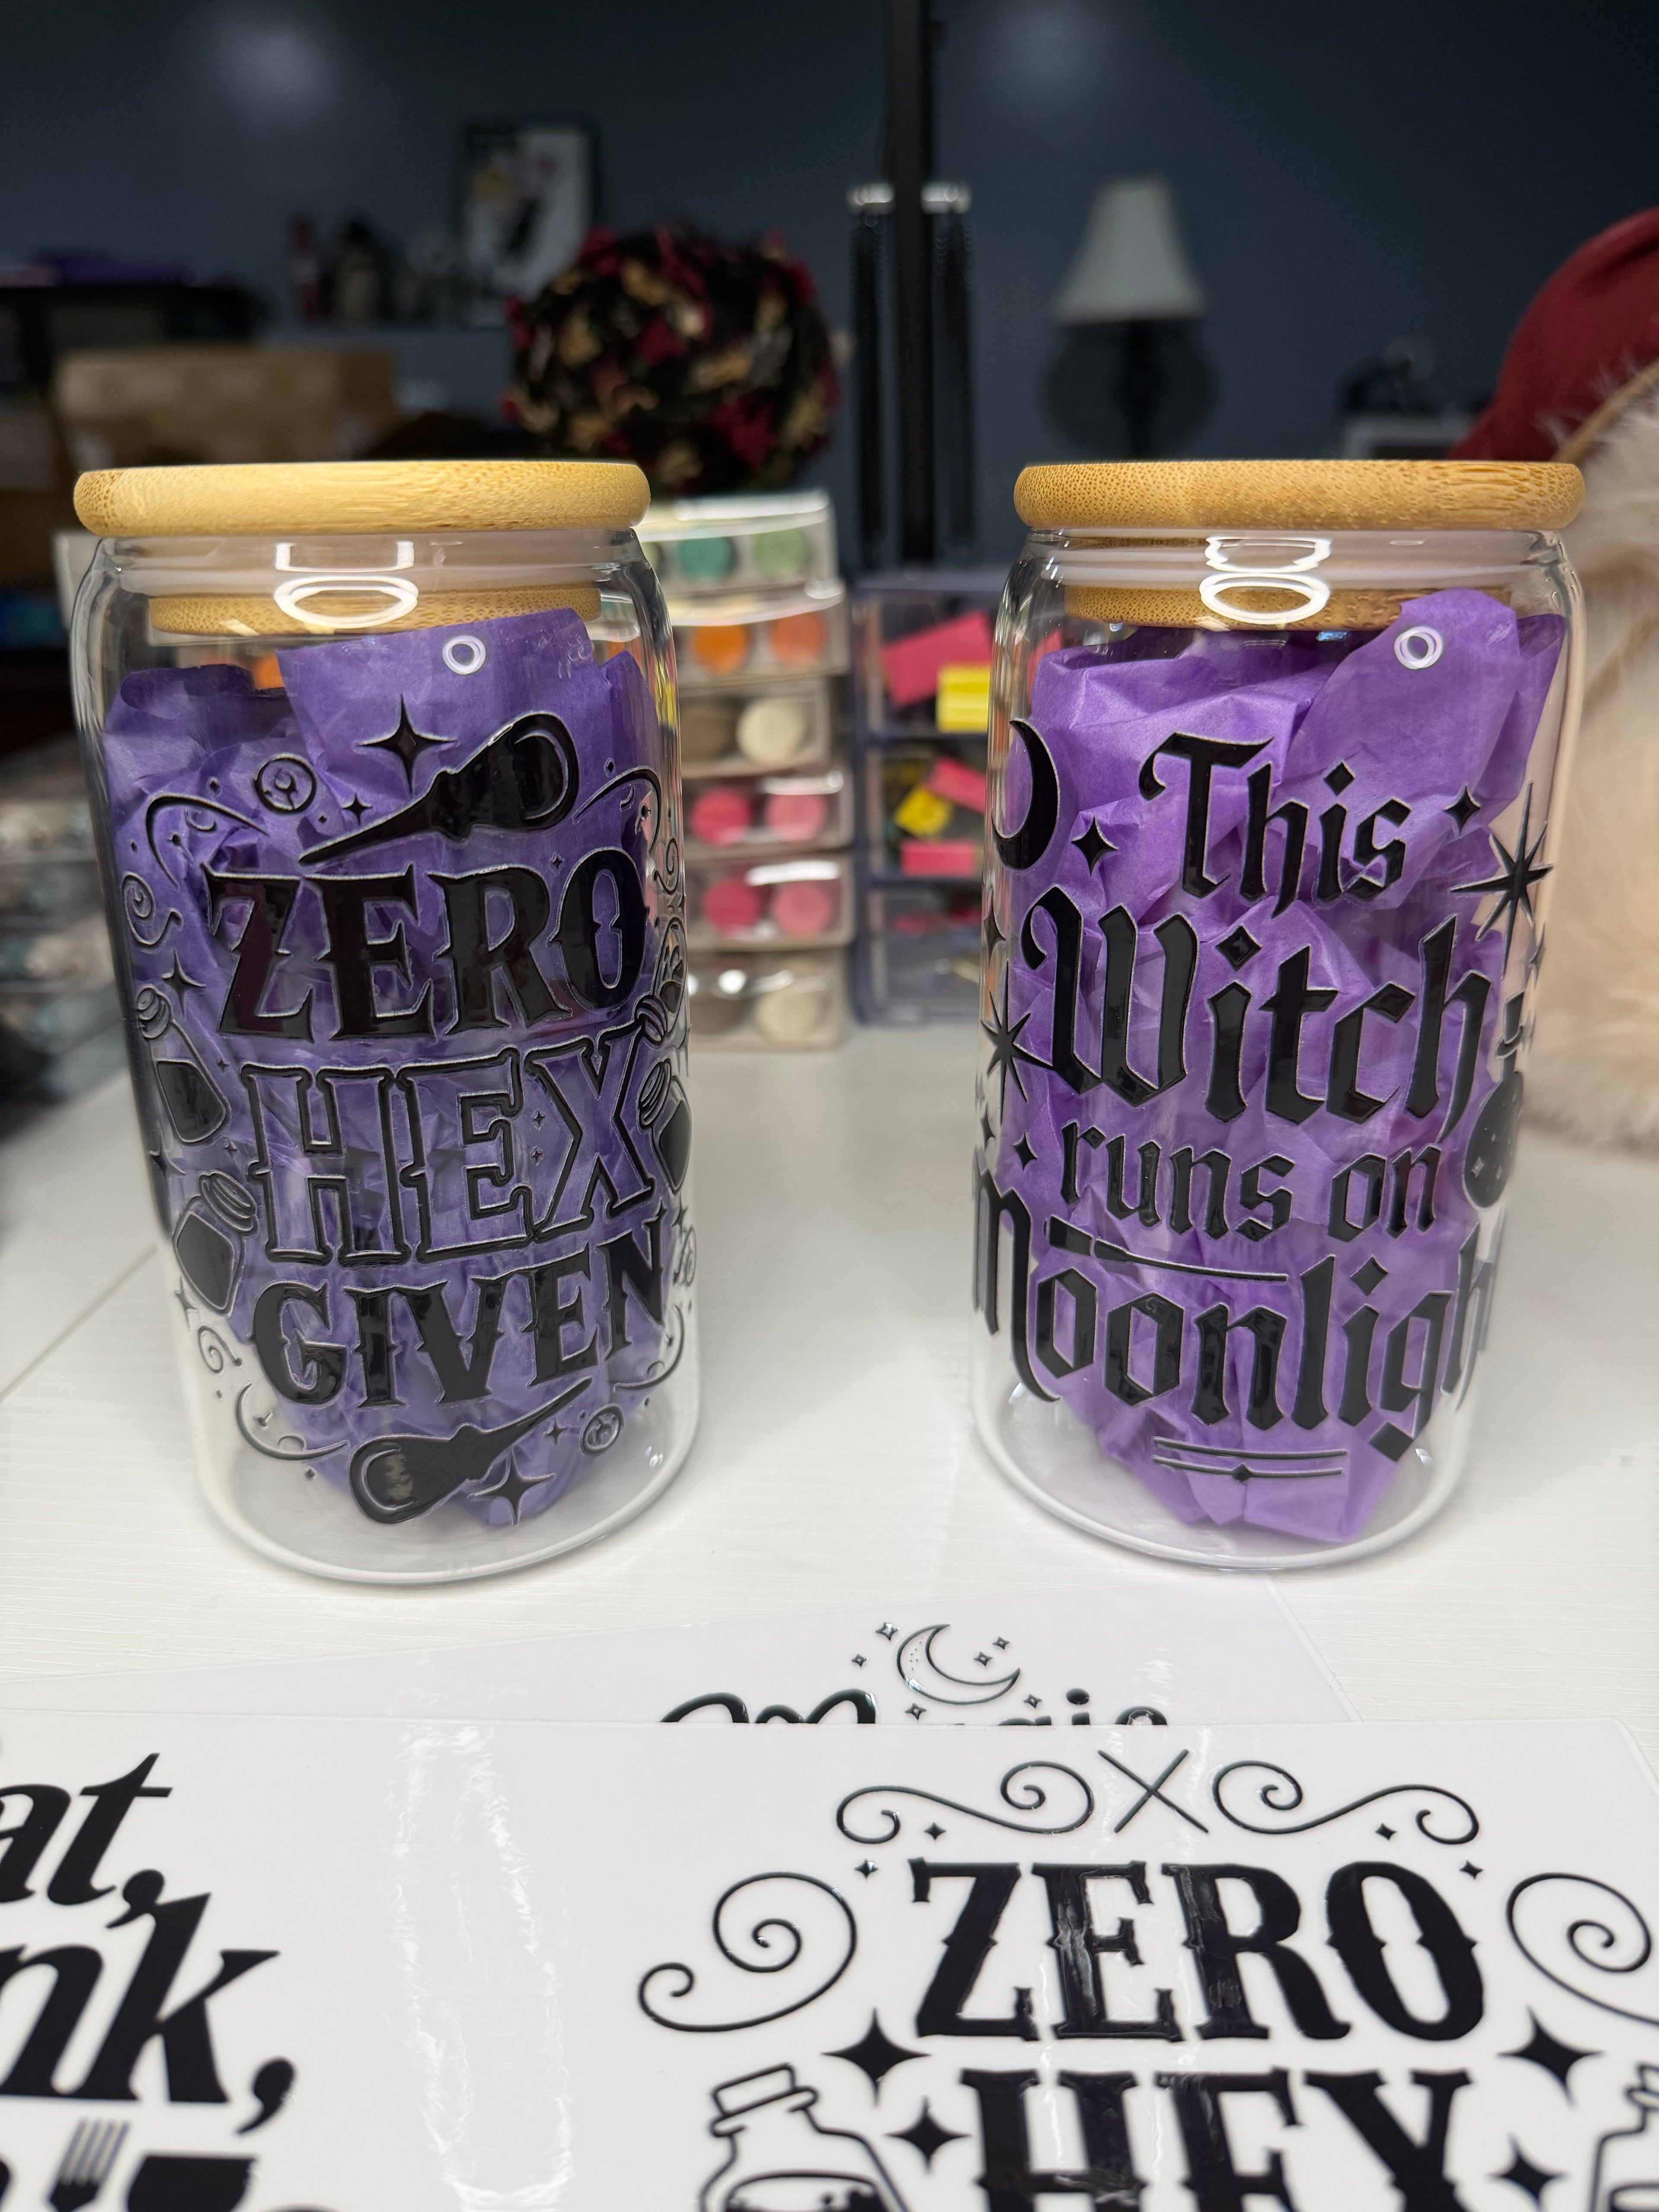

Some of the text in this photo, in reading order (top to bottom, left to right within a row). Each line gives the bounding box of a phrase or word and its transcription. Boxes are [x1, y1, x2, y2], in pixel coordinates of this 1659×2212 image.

[1138, 731, 1412, 918] This
[202, 847, 650, 1043] ZERO
[1020, 884, 1491, 1143] Witch
[239, 1017, 657, 1267] HEX
[1060, 1118, 1442, 1243] runs on
[248, 1196, 665, 1408] GIVEN
[907, 1858, 1485, 2042] ZERO
